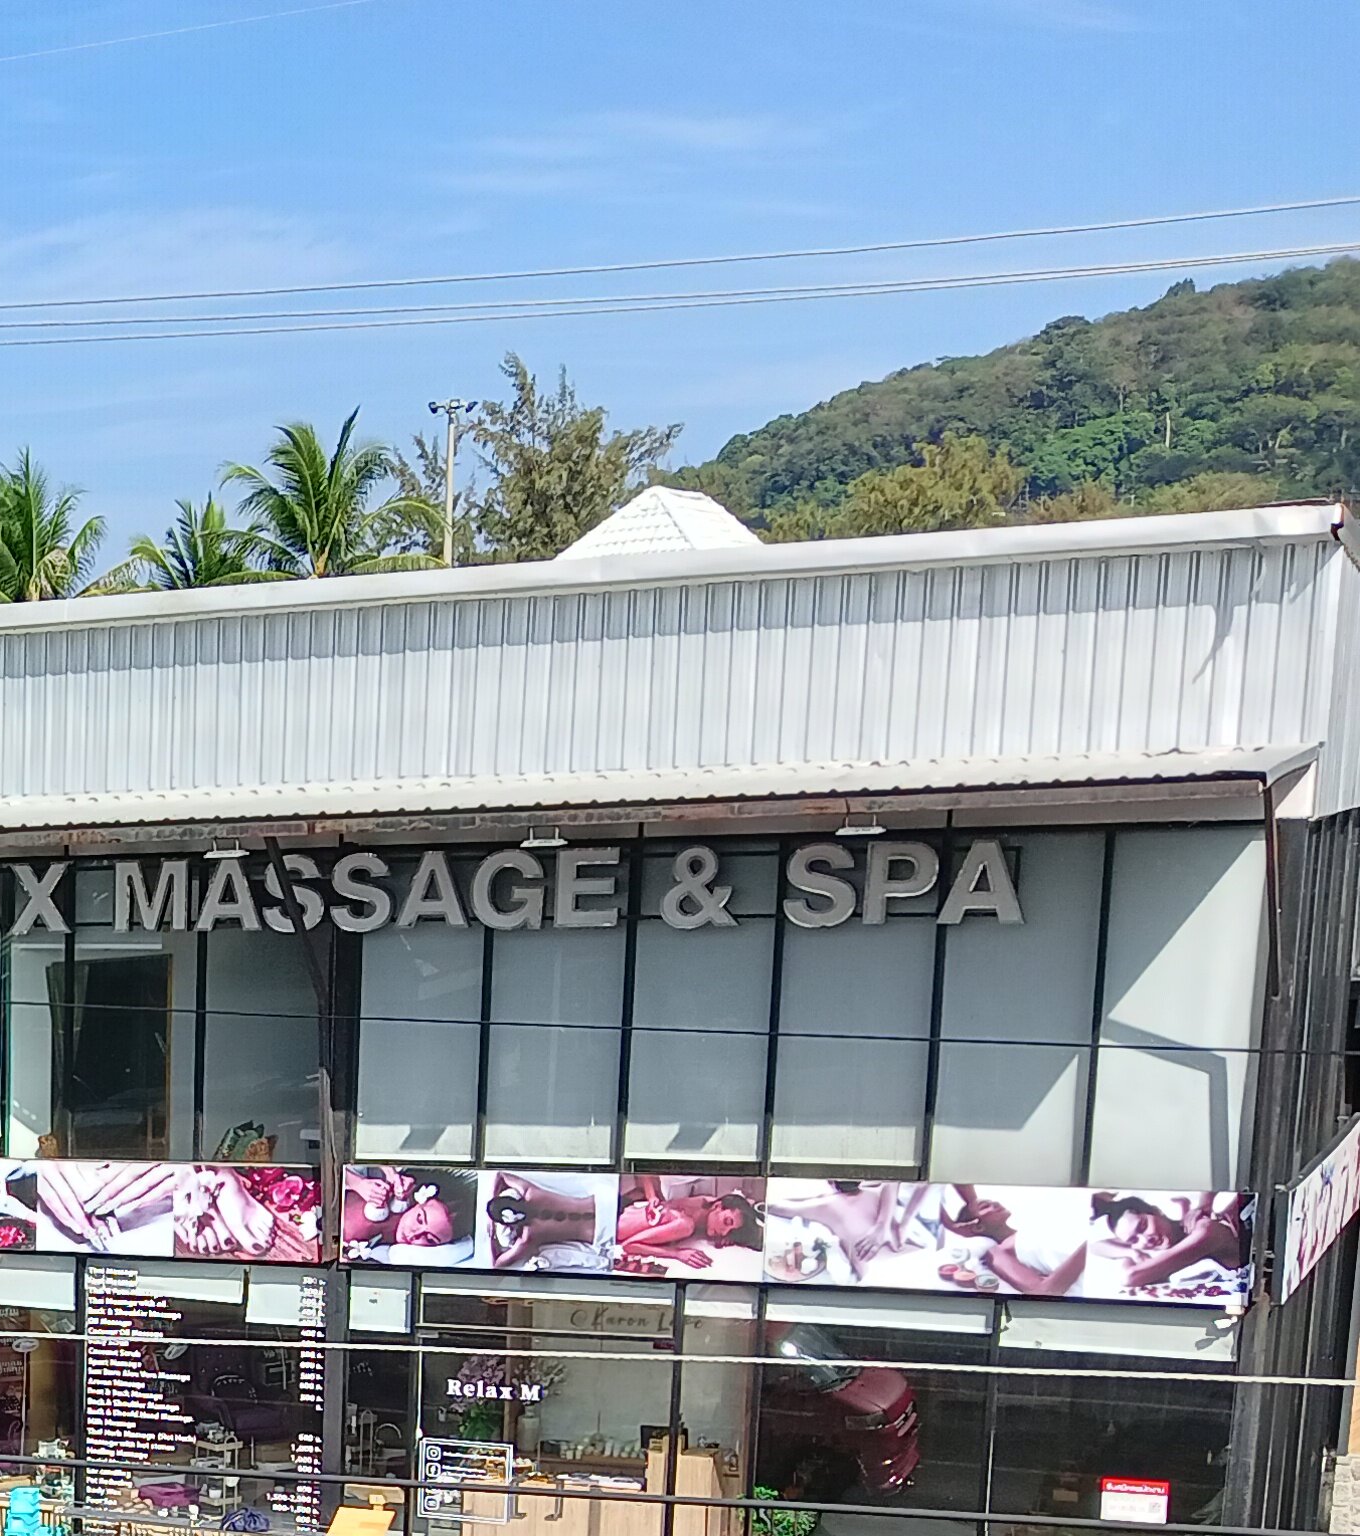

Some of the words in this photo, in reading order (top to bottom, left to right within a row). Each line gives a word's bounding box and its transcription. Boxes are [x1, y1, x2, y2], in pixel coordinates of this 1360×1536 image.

[114, 846, 621, 934] MASSAGE
[660, 844, 738, 930] &
[783, 839, 1024, 928] SPA
[446, 1378, 513, 1400] Relax
[520, 1384, 541, 1401] M
